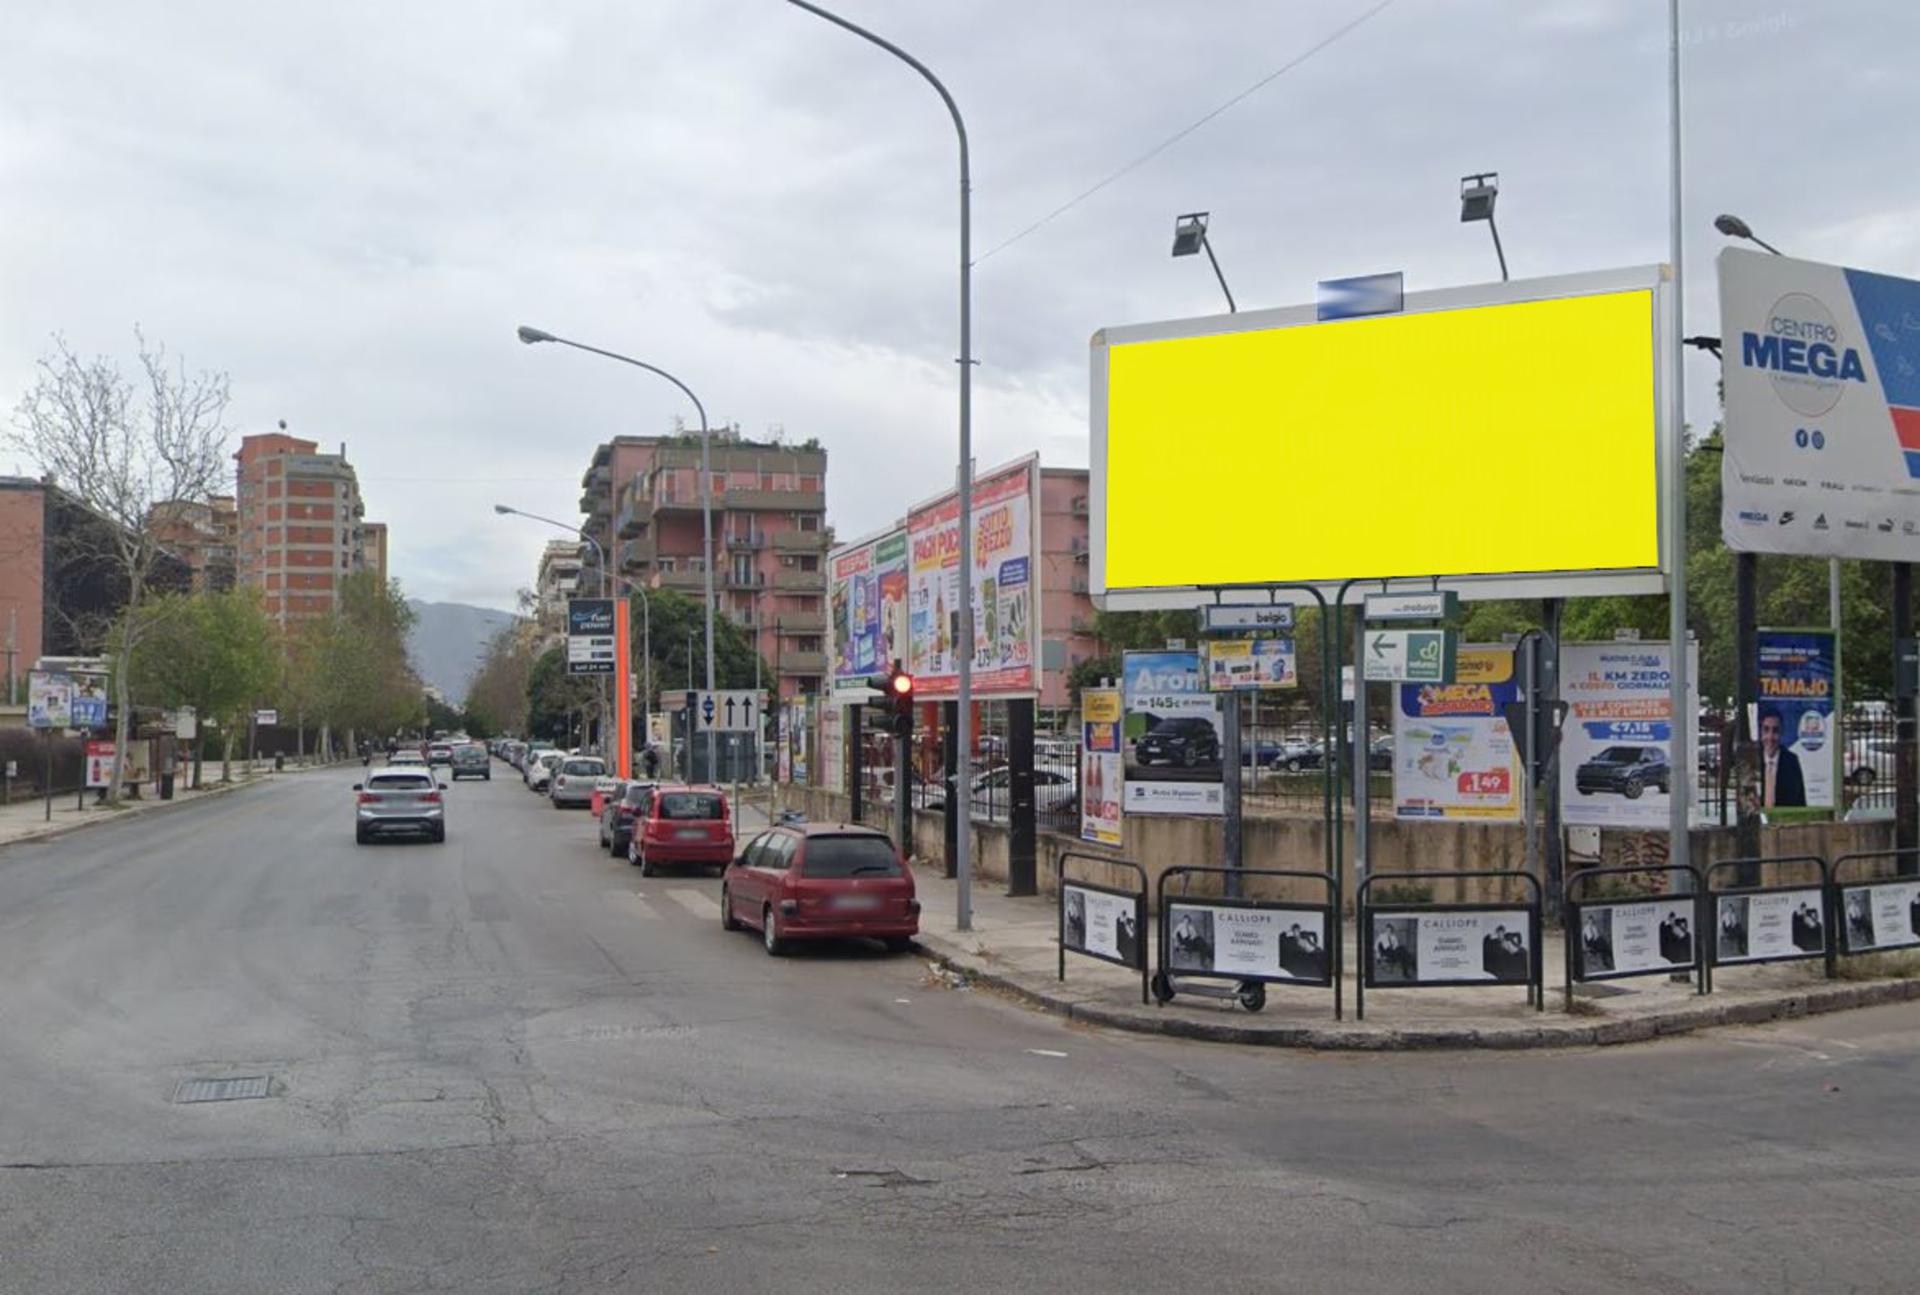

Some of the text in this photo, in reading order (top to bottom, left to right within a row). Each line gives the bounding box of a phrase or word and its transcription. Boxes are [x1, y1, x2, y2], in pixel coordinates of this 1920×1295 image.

[1771, 316, 1838, 343] CENTRO
[1743, 332, 1868, 382] MEGA
[1605, 671, 1627, 681] KM
[1632, 671, 1671, 681] ZERO
[1760, 678, 1829, 695] TAMAJO
[1218, 913, 1271, 924] CALLIOPE
[1423, 919, 1479, 928] CALLIOPE
